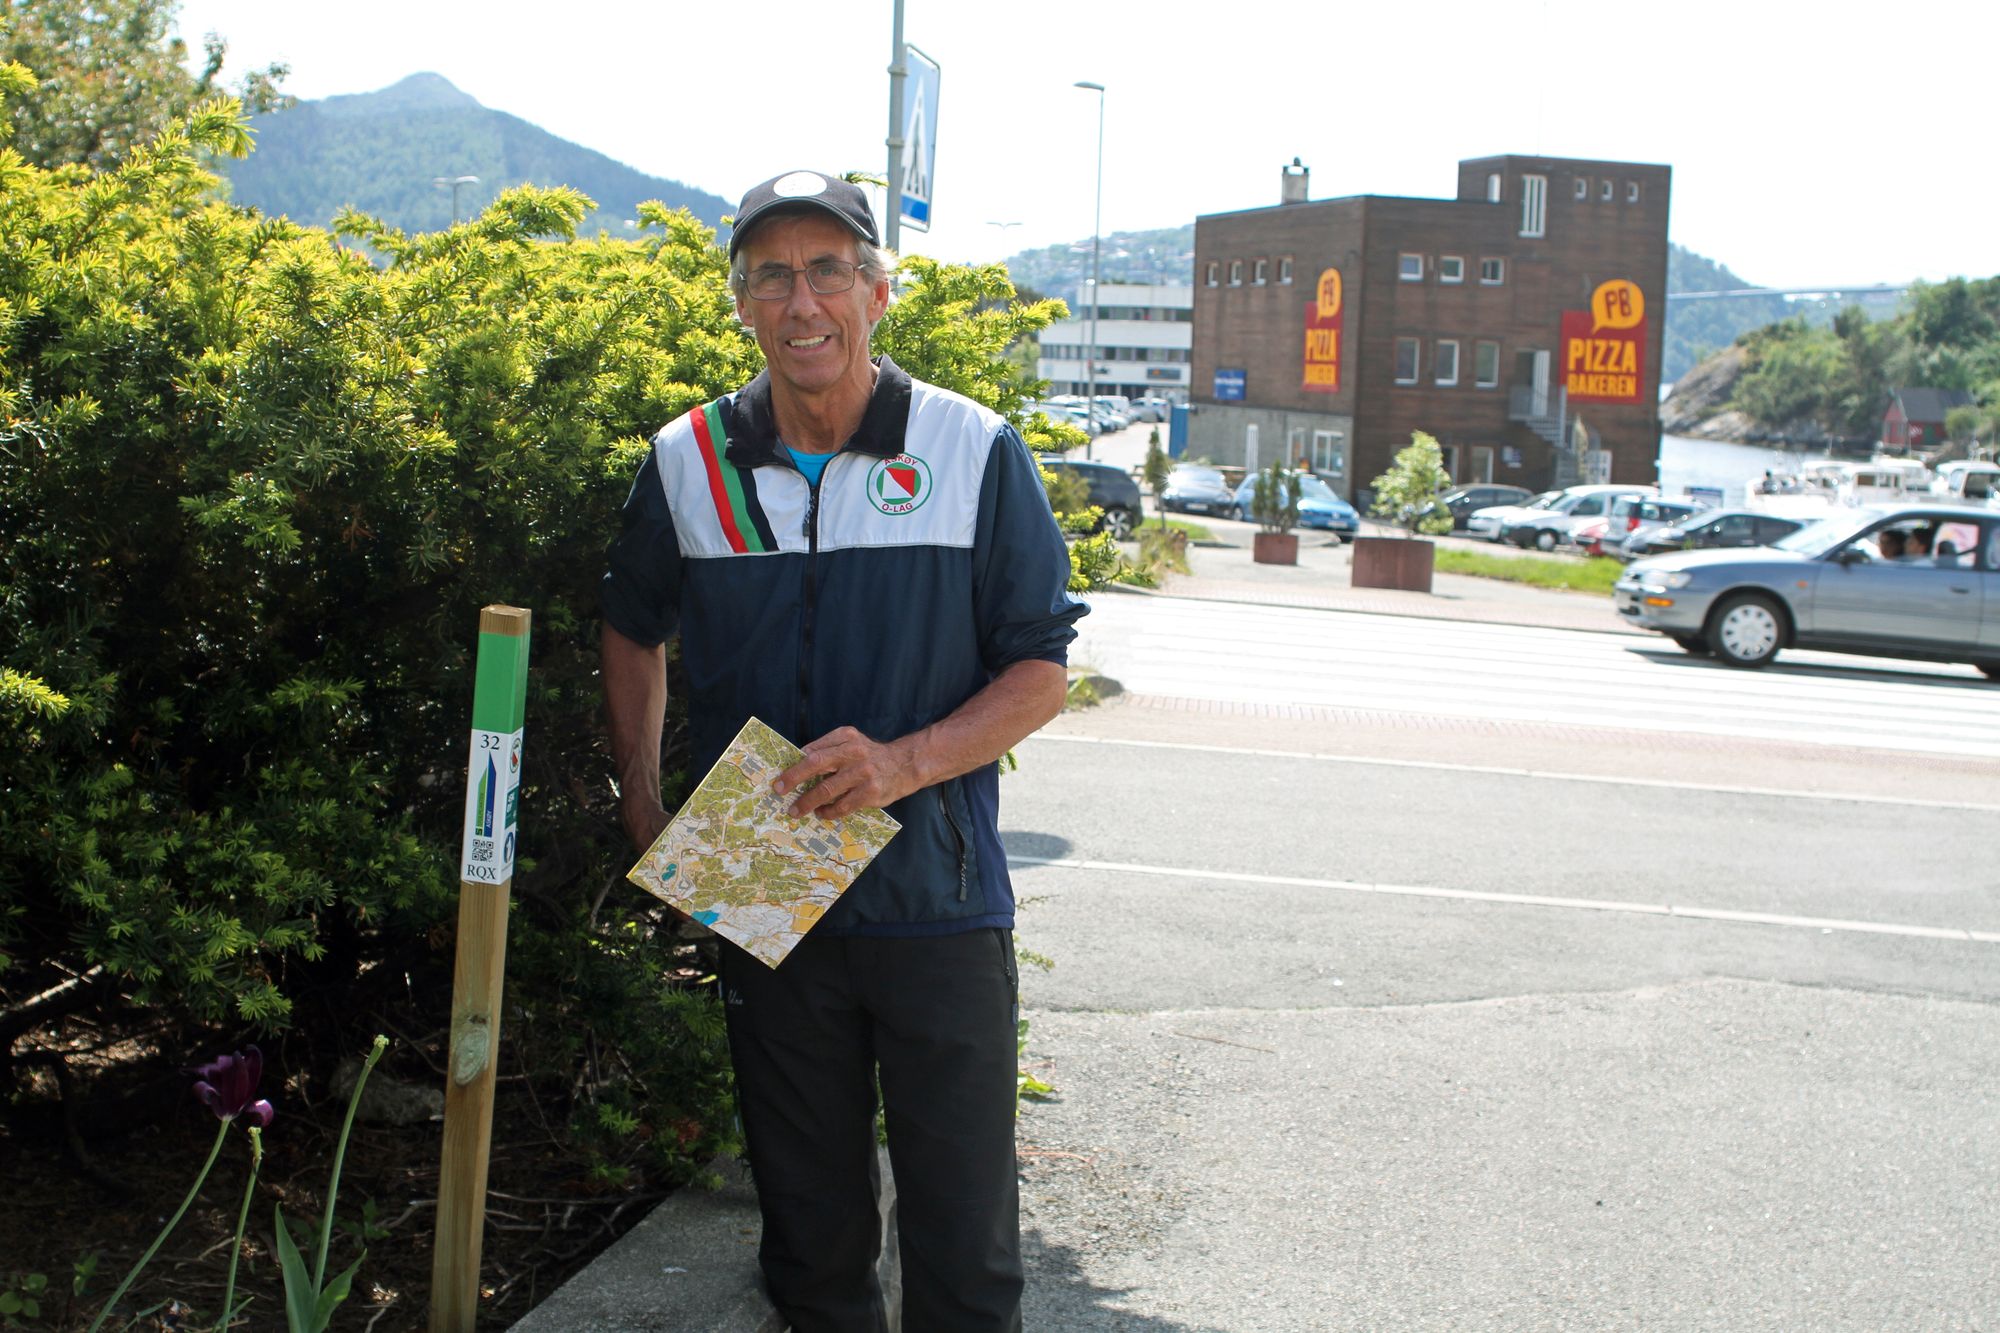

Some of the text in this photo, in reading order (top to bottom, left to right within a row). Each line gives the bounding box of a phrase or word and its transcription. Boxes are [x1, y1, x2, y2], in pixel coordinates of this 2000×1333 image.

[1604, 287, 1632, 319] PB
[1305, 329, 1337, 361] PIZZA
[1568, 338, 1637, 373] PIZZA
[1567, 373, 1637, 397] BAKEREN
[882, 502, 913, 513] O-LAG
[480, 734, 500, 750] 32
[466, 864, 497, 880] RQX
